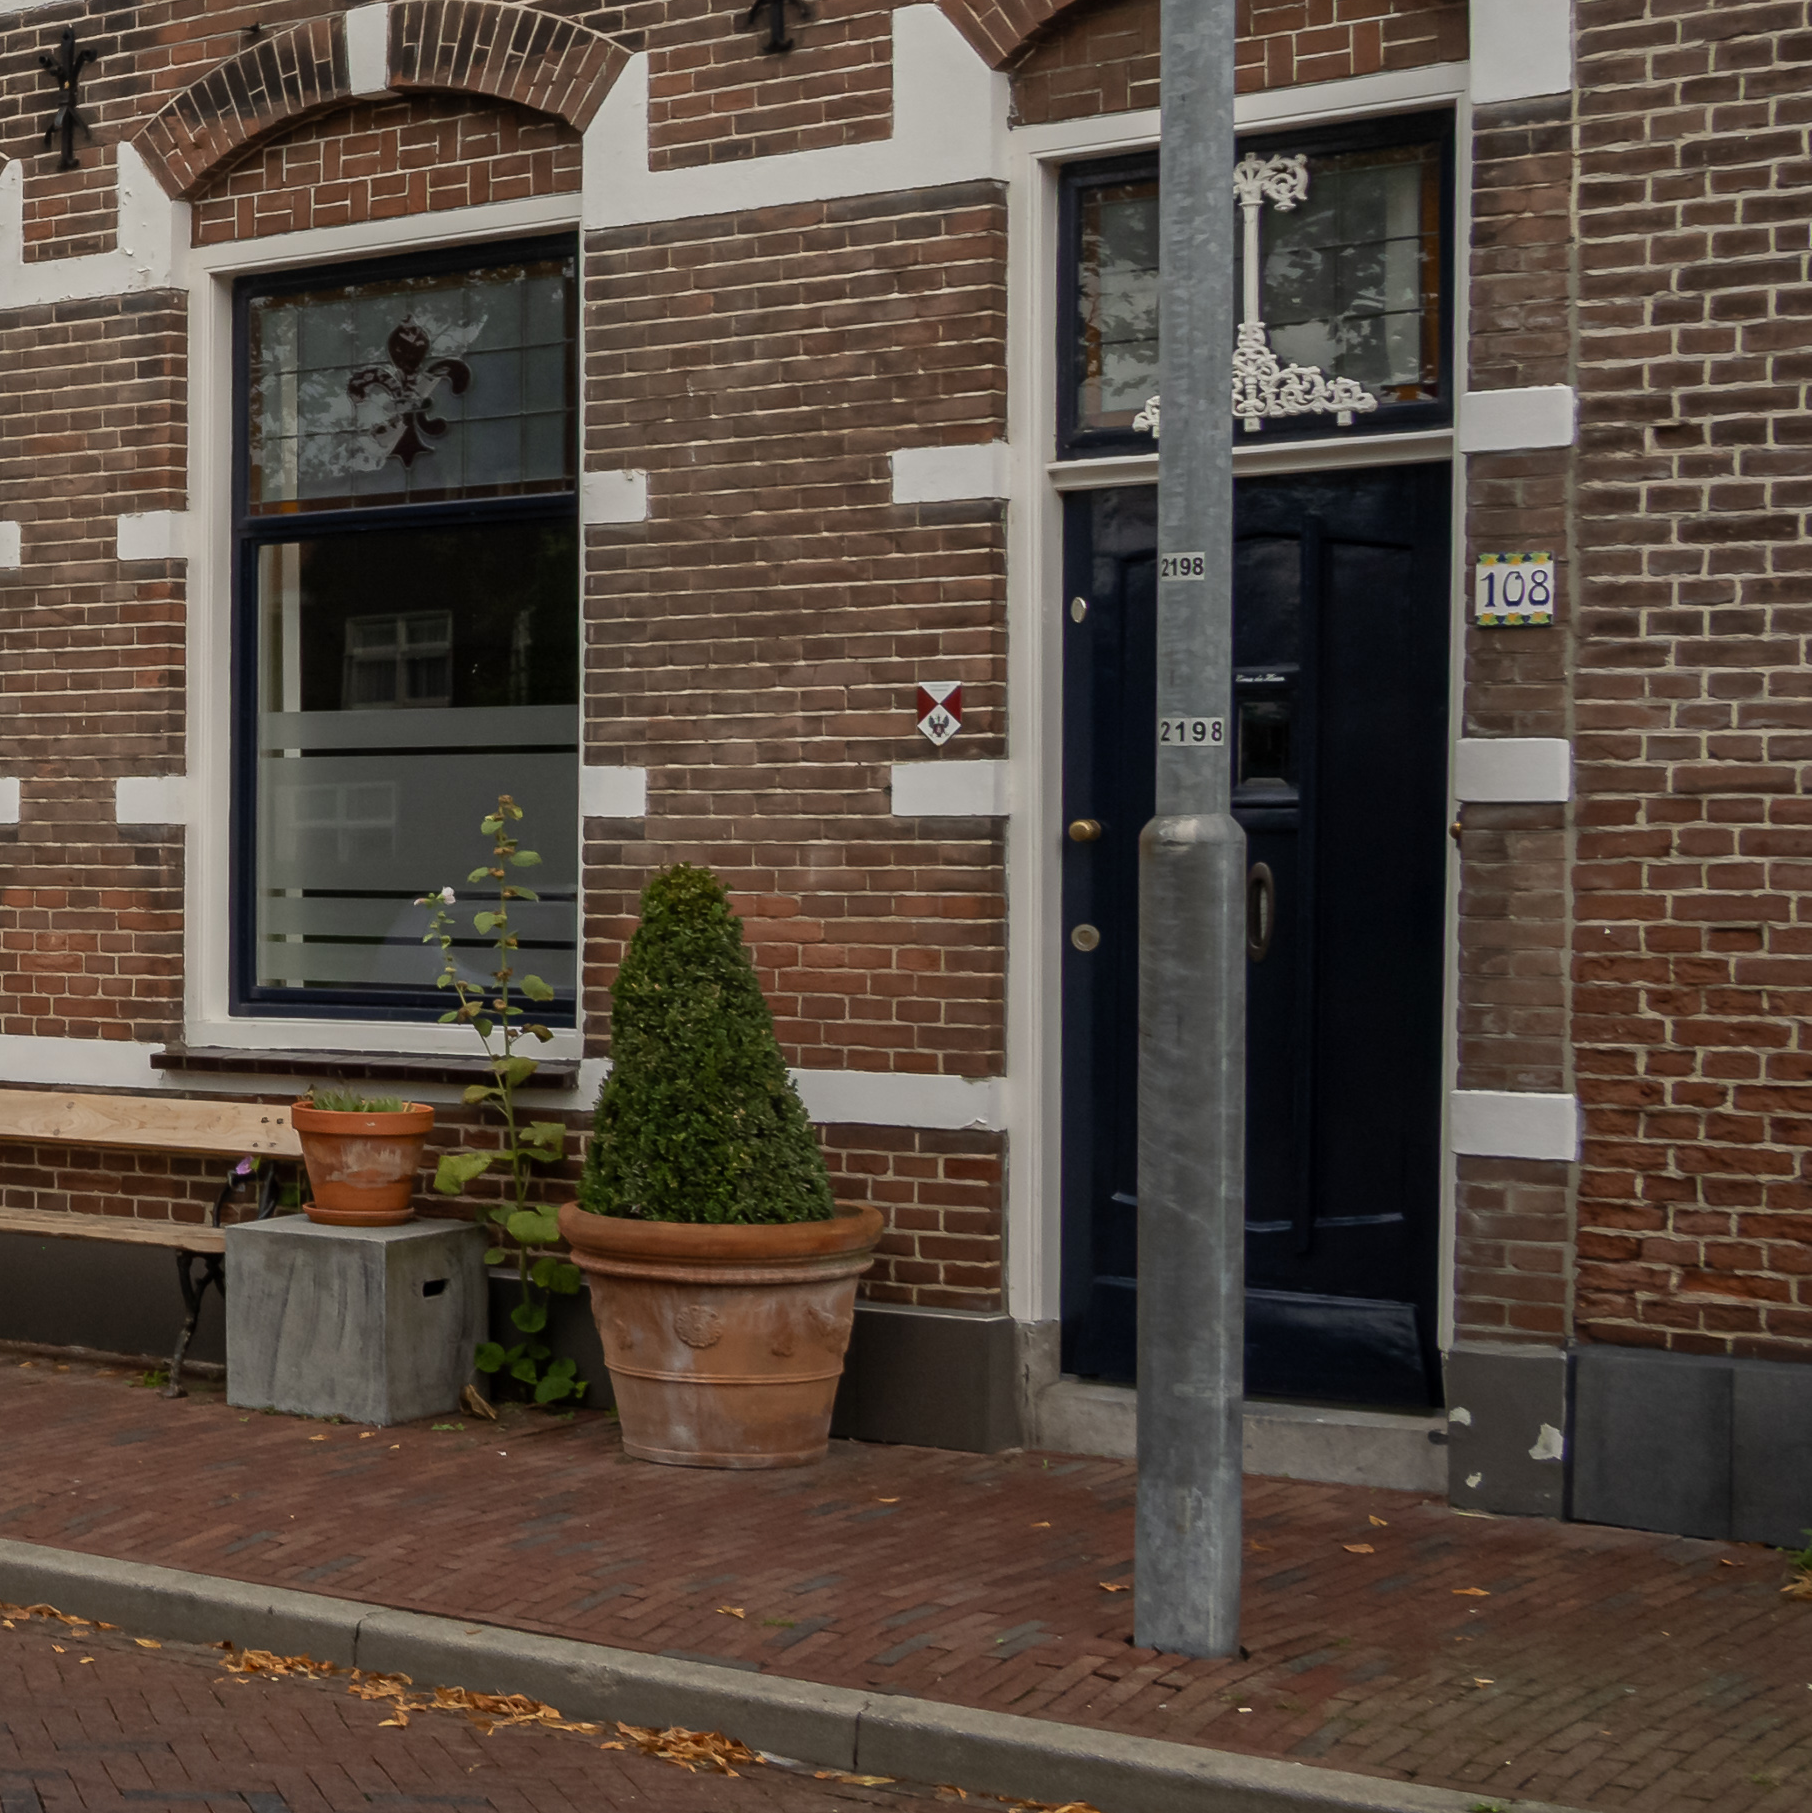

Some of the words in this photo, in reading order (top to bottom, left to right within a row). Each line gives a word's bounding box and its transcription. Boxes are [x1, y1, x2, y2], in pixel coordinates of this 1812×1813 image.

[1161, 557, 1204, 577] 2198
[1480, 569, 1550, 608] 108
[1160, 720, 1223, 742] 2198
